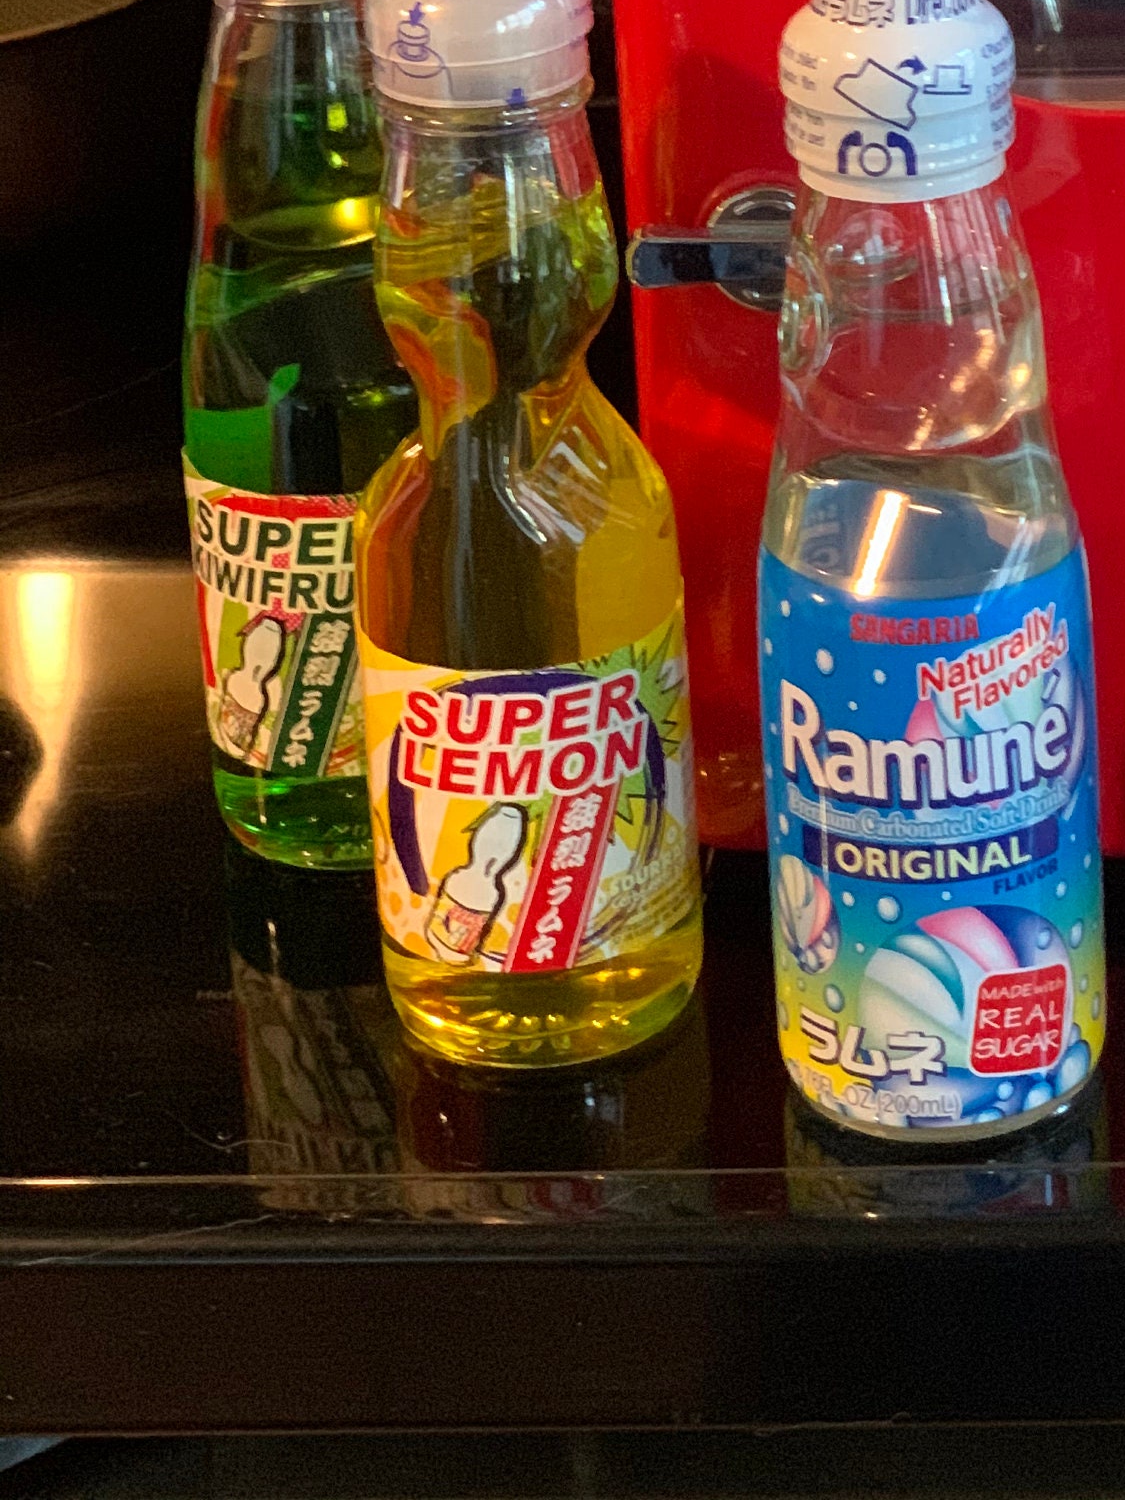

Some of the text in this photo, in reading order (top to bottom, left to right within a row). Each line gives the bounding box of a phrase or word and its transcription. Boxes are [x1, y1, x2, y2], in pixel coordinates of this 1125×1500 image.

[849, 612, 979, 646] SANGARIA
[916, 603, 1058, 700] Naturally
[952, 622, 1069, 720] Flavored
[404, 673, 638, 746] SUPER
[402, 719, 644, 796] LEMON
[859, 809, 973, 840] Carbonated
[834, 835, 1033, 881] ORIGINAL
[993, 858, 1059, 895] FLAVOR
[980, 981, 1033, 1001] MADE
[978, 1000, 1063, 1031] REAL
[799, 1005, 948, 1086] ラムネ
[974, 1029, 1062, 1060] SUGAR
[876, 1089, 962, 1117] (200mL)
